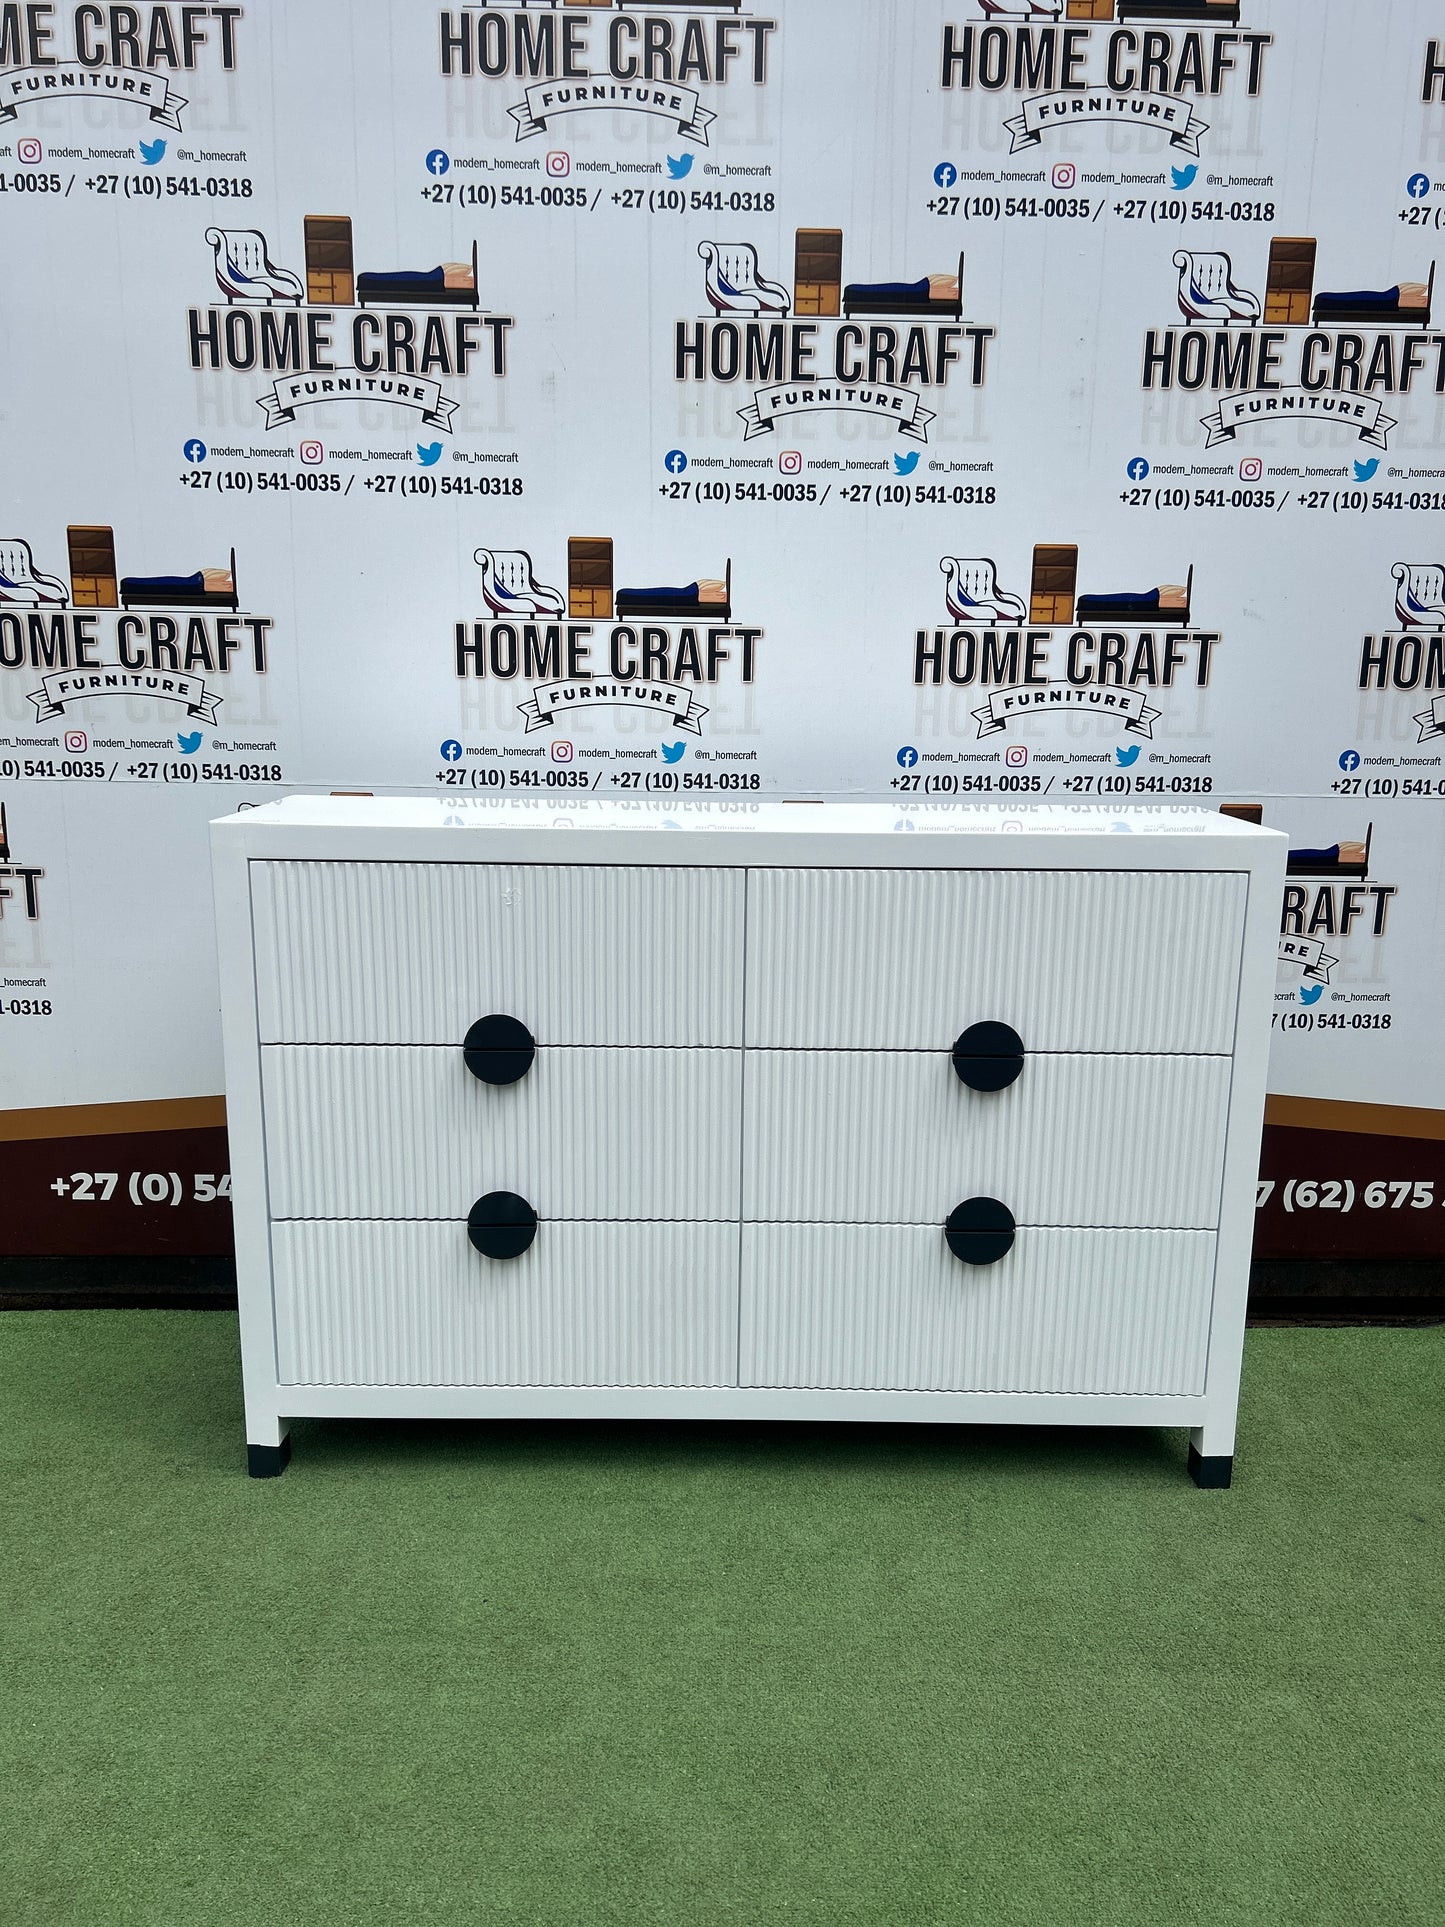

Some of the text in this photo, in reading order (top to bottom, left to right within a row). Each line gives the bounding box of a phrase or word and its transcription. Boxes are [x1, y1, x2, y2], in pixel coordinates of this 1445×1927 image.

[75, 5, 240, 68] CRAFT
[441, 13, 773, 82] HOME CRAFT
[942, 26, 1273, 94] HOME CRAFT
[10, 73, 151, 96] FURNITURE
[541, 86, 681, 110] FURNITURE
[1038, 98, 1176, 121] FURNITURE
[176, 149, 247, 162] @m_homecraft
[703, 164, 771, 177] @m_homecraft
[1206, 175, 1273, 187] @m_homecraft
[84, 175, 118, 194] +27
[123, 176, 161, 199] (10)
[165, 177, 252, 197] 541-0318
[420, 184, 454, 203] +27
[458, 185, 496, 209] (10)
[500, 186, 587, 207] 541-0035
[610, 189, 644, 208] +27
[648, 190, 686, 214] (10)
[689, 191, 775, 212] 541-0318
[926, 197, 960, 215] +27
[963, 197, 1000, 221] (10)
[1004, 198, 1089, 218] 541-0035
[1113, 200, 1147, 218] +27
[1150, 201, 1187, 224] (10)
[1190, 201, 1275, 221] 541-0318
[1397, 207, 1431, 225] +27
[189, 310, 511, 374] HOME CRAFT
[677, 322, 995, 384] HOME CRAFT
[1143, 331, 1284, 389] HOME
[289, 378, 425, 400] FURNITURE
[770, 389, 903, 410] FURNITURE
[1234, 397, 1366, 418] FURNITURE
[452, 451, 519, 463] @m_homecraft
[928, 461, 993, 472] @m_homecraft
[179, 471, 212, 488] +27
[216, 472, 253, 493] (10)
[256, 472, 340, 491] 541-0035
[363, 475, 396, 492] +27
[400, 476, 436, 498] (10)
[440, 477, 523, 496] 541-0318
[658, 482, 691, 499] +27
[694, 482, 730, 504] (10)
[734, 483, 817, 501] 541-0035
[839, 485, 871, 502] +27
[875, 485, 911, 507] (10)
[914, 486, 995, 504] 541-0318
[1119, 489, 1151, 505] +27
[1154, 489, 1190, 510] (10)
[1193, 490, 1275, 508] 541-0035
[1297, 491, 1330, 508] +27
[1332, 492, 1368, 513] (10)
[118, 616, 273, 671] CRAFT
[456, 624, 763, 681] HOME CRAFT
[915, 631, 1218, 687] HOME CRAFT
[57, 675, 189, 695] FURNITURE
[548, 686, 677, 706] FURNITURE
[1003, 690, 1130, 710] FURNITURE
[211, 740, 276, 751] @m_homecraft
[694, 750, 757, 761] @m_homecraft
[1148, 753, 1211, 764] @m_homecraft
[23, 760, 105, 779] 541-0035
[126, 763, 158, 779] +27
[162, 763, 197, 783] (10)
[201, 764, 282, 781] 541-0318
[435, 769, 466, 784] +27
[469, 769, 505, 790] (10)
[508, 770, 588, 790] 541-0035
[610, 772, 641, 788] +27
[644, 772, 679, 791] (10)
[682, 773, 760, 790] 541-0318
[889, 775, 921, 791] +27
[923, 774, 958, 795] (10)
[961, 775, 1041, 793] 541-0035
[1062, 776, 1094, 791] +27
[1096, 776, 1131, 796] (10)
[1134, 776, 1212, 793] 541-0318
[1330, 779, 1362, 794] +27
[1364, 779, 1398, 799] (10)
[1330, 992, 1390, 1002] @m_homecraft
[1280, 1014, 1313, 1032] (10)
[1316, 1014, 1391, 1029] 541-0318
[50, 1173, 118, 1200] +27
[128, 1172, 182, 1205] (0)
[1283, 1180, 1354, 1212] (62)
[1364, 1182, 1434, 1208] 675
